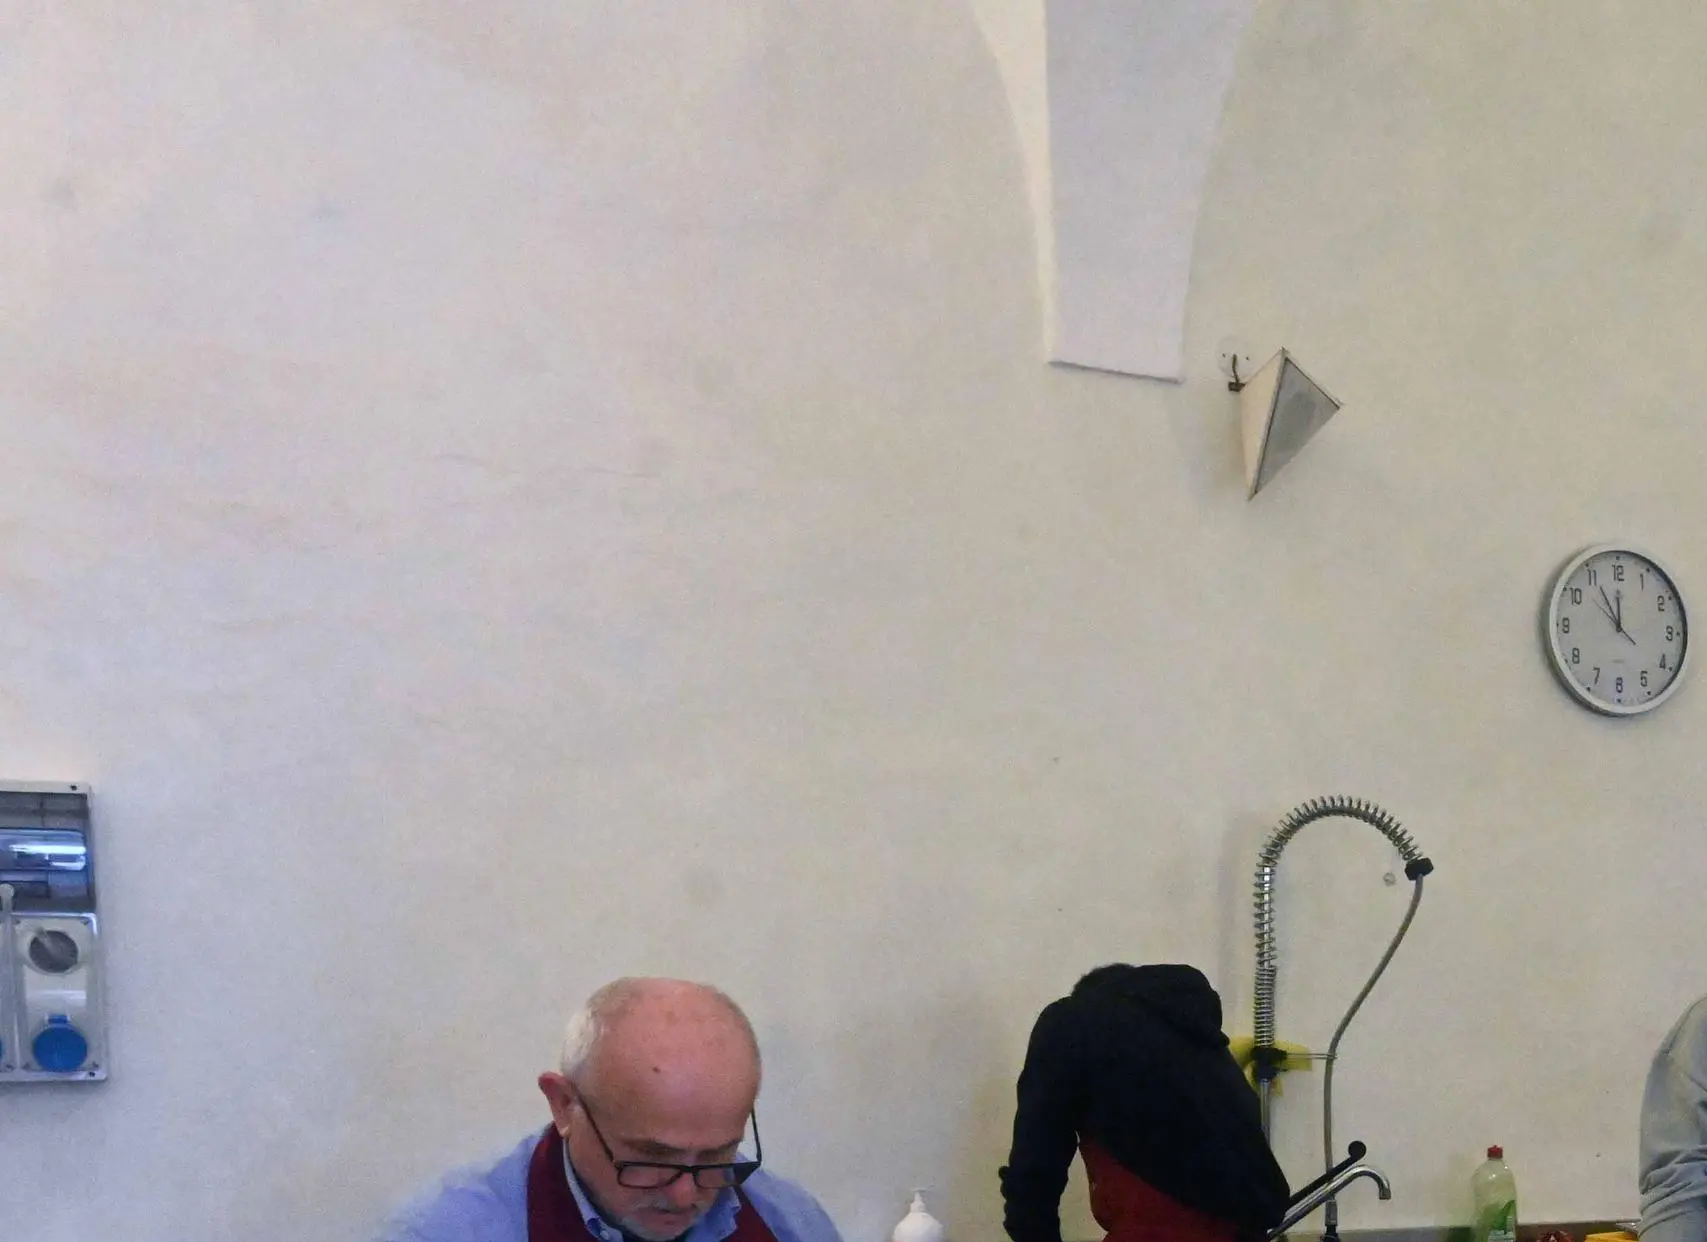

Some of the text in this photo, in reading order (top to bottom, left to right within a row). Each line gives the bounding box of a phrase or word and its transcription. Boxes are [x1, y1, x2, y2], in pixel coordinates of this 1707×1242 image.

[1588, 569, 1597, 586] 11
[1612, 564, 1625, 581] 12
[1640, 573, 1644, 591] 1
[1570, 587, 1583, 605] 10
[1657, 595, 1665, 612] 2
[1666, 625, 1673, 641] 3
[1572, 647, 1580, 664] 8
[1659, 653, 1666, 670] 4
[1593, 667, 1600, 684] 7
